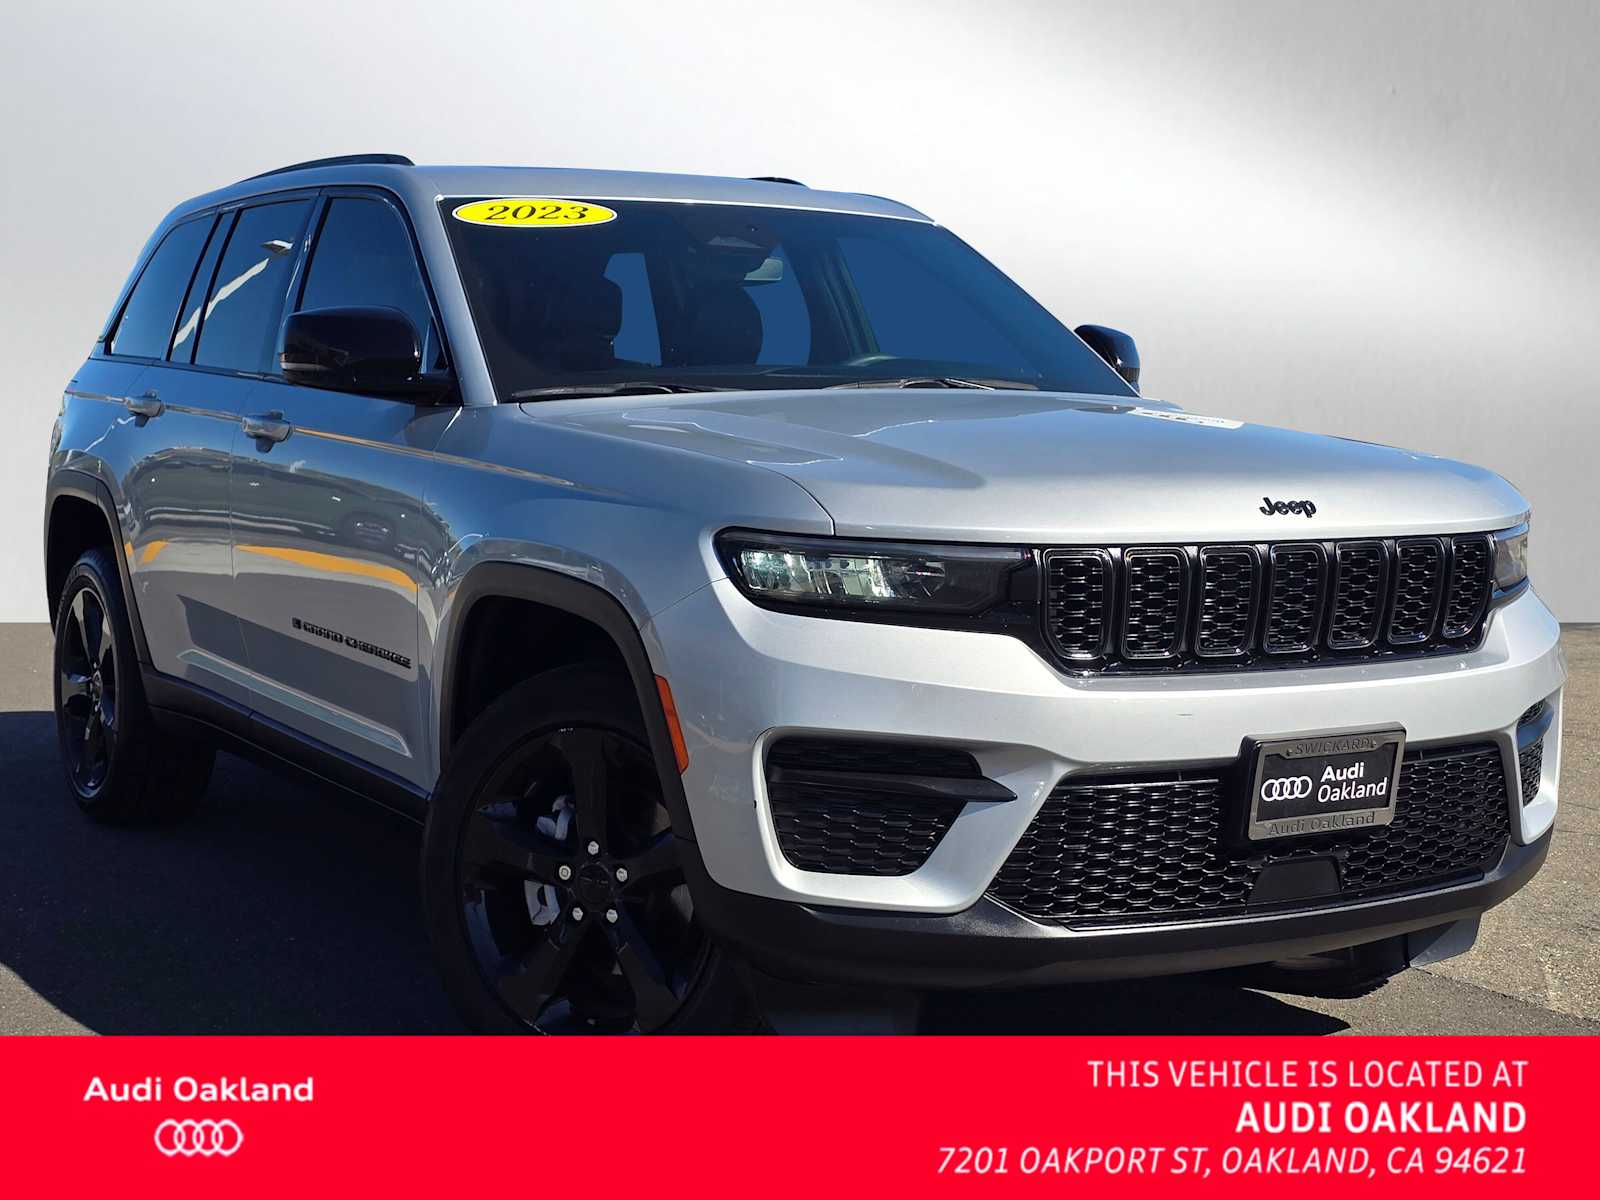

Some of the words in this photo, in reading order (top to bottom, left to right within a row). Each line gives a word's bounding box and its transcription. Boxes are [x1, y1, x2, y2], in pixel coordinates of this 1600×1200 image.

[485, 205, 589, 220] 2023
[1259, 497, 1317, 518] Jeep
[1296, 738, 1371, 755] SWICKARD
[1320, 761, 1366, 783] Audi
[1317, 776, 1388, 803] Oakland
[1268, 819, 1306, 836] Audi
[1310, 811, 1376, 831] Oakland
